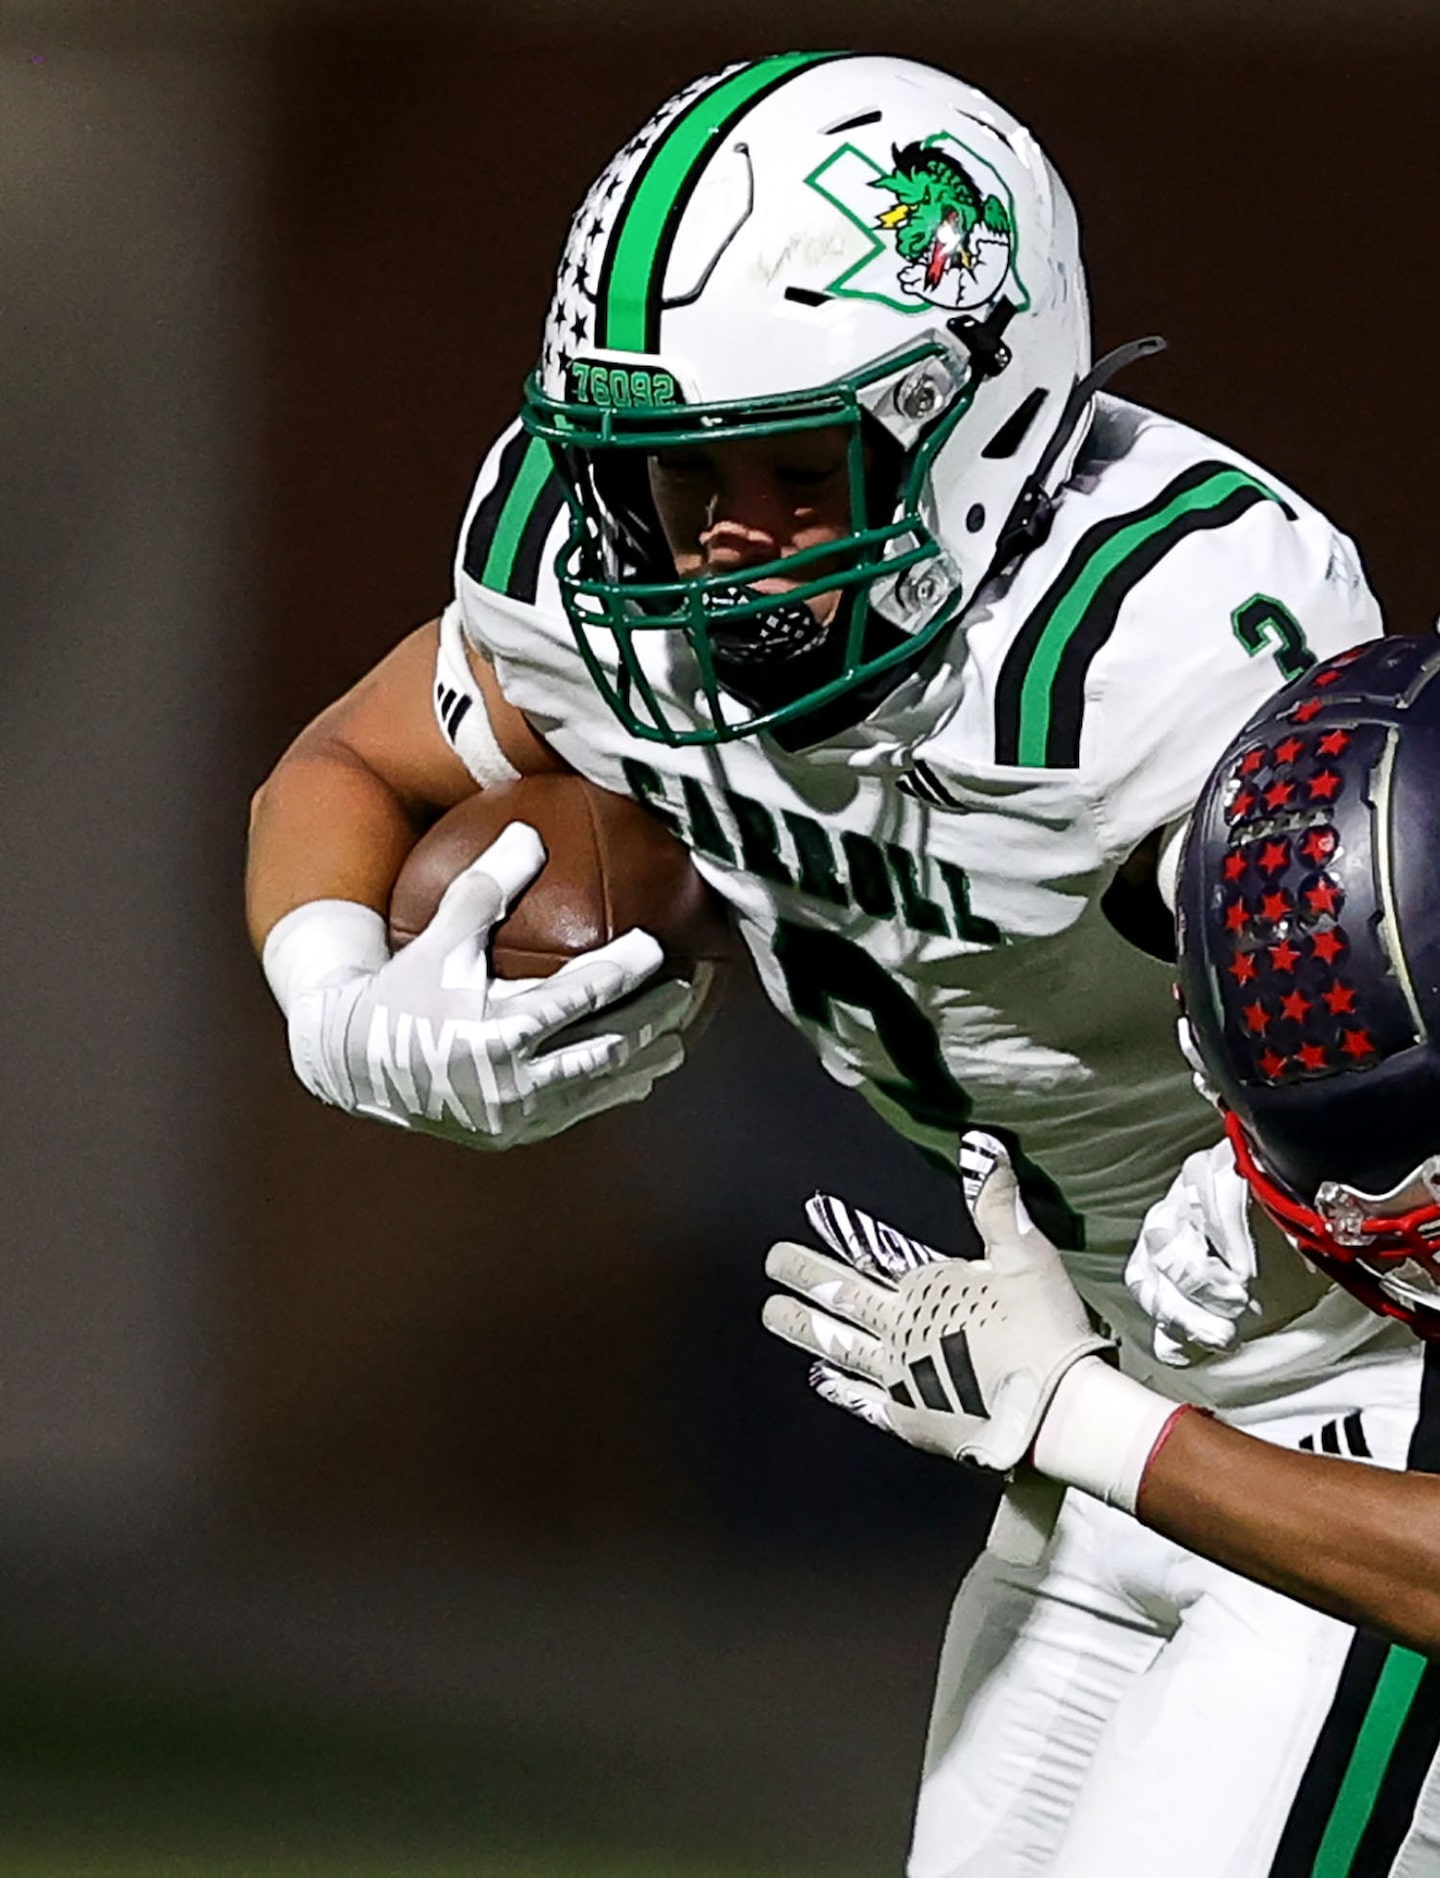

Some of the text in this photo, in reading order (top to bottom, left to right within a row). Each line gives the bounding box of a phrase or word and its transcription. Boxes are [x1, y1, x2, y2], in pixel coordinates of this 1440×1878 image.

[571, 361, 677, 407] 76092
[620, 756, 1001, 944] CARROLL
[366, 1004, 502, 1136] NXT
